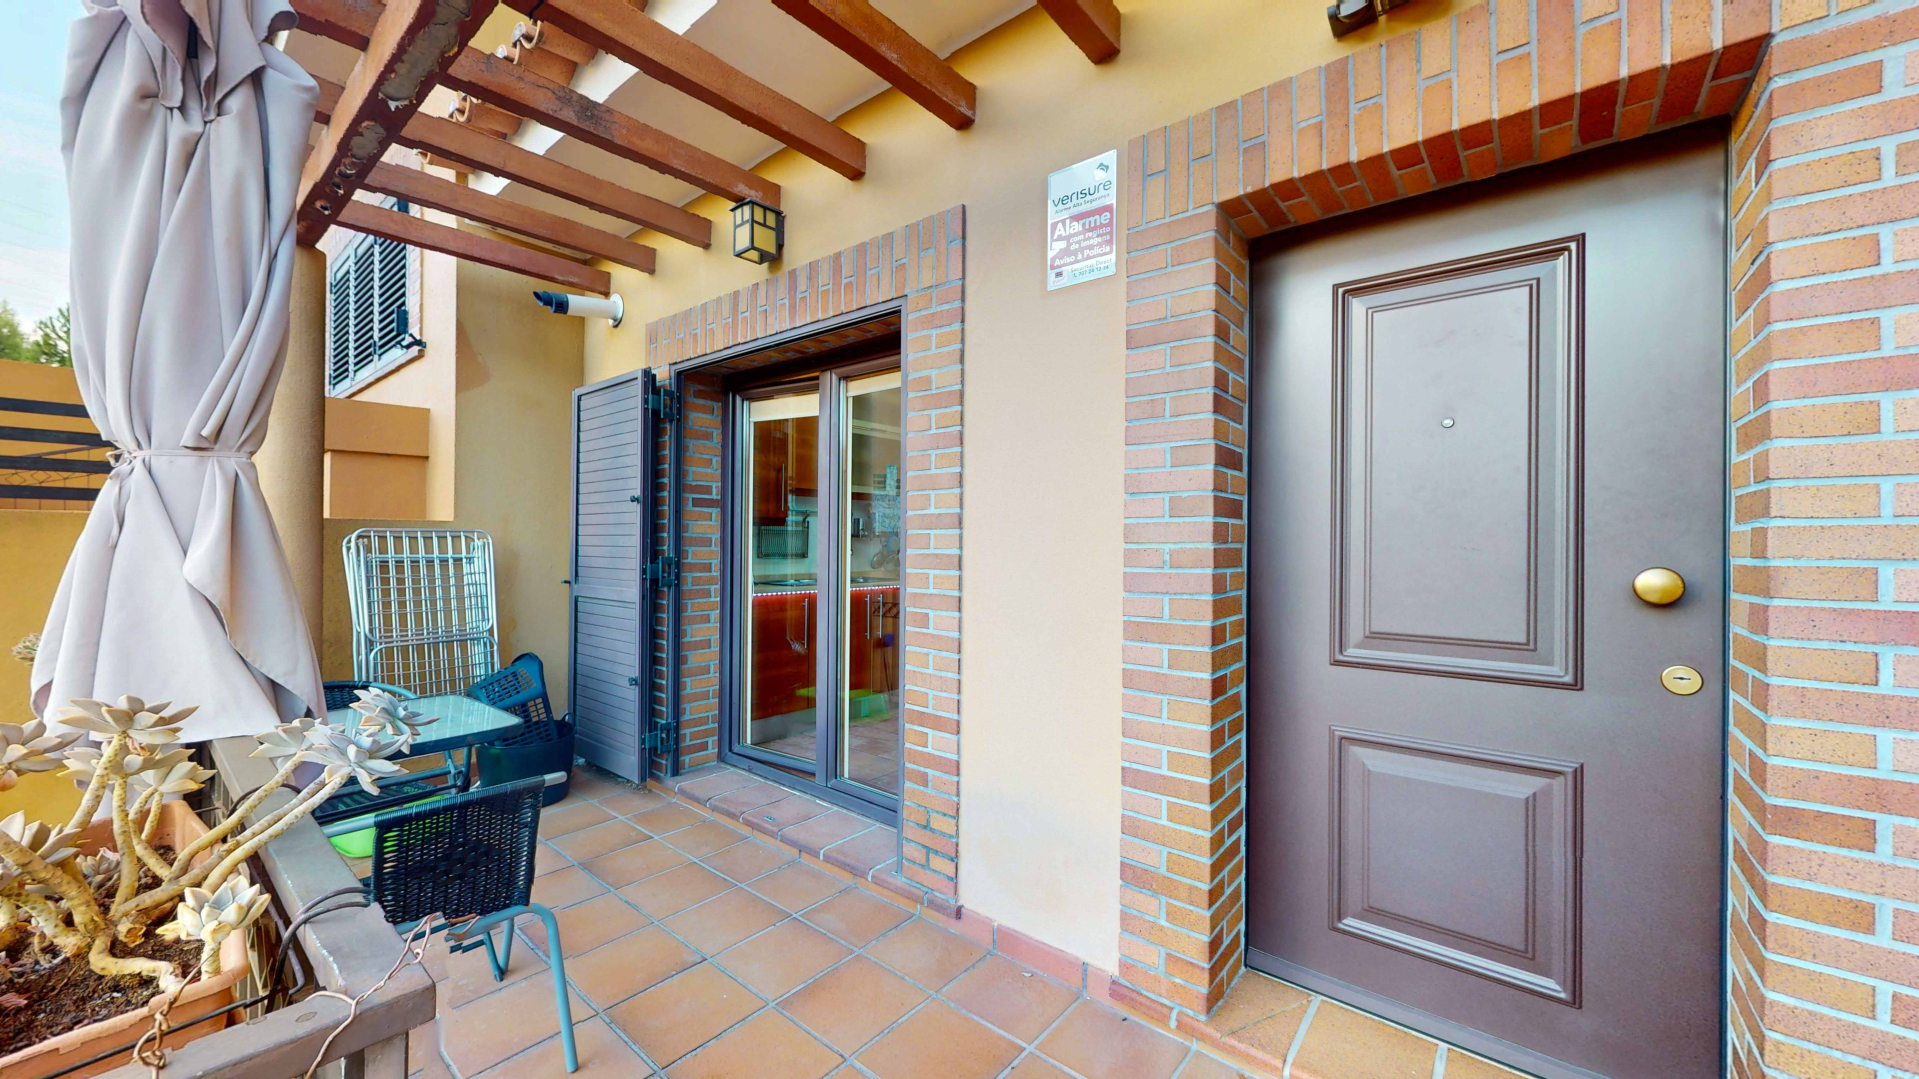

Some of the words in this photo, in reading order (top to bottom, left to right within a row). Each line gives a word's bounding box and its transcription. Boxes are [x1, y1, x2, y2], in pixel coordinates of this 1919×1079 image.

[1052, 180, 1112, 207] verisure
[1053, 211, 1111, 240] Alarme
[1069, 234, 1084, 243] com
[1085, 226, 1111, 239] registo
[1070, 243, 1080, 251] de
[1080, 234, 1110, 247] imagens
[1054, 255, 1076, 266] Aviso
[1077, 251, 1082, 260] à
[1083, 244, 1111, 258] Polícia
